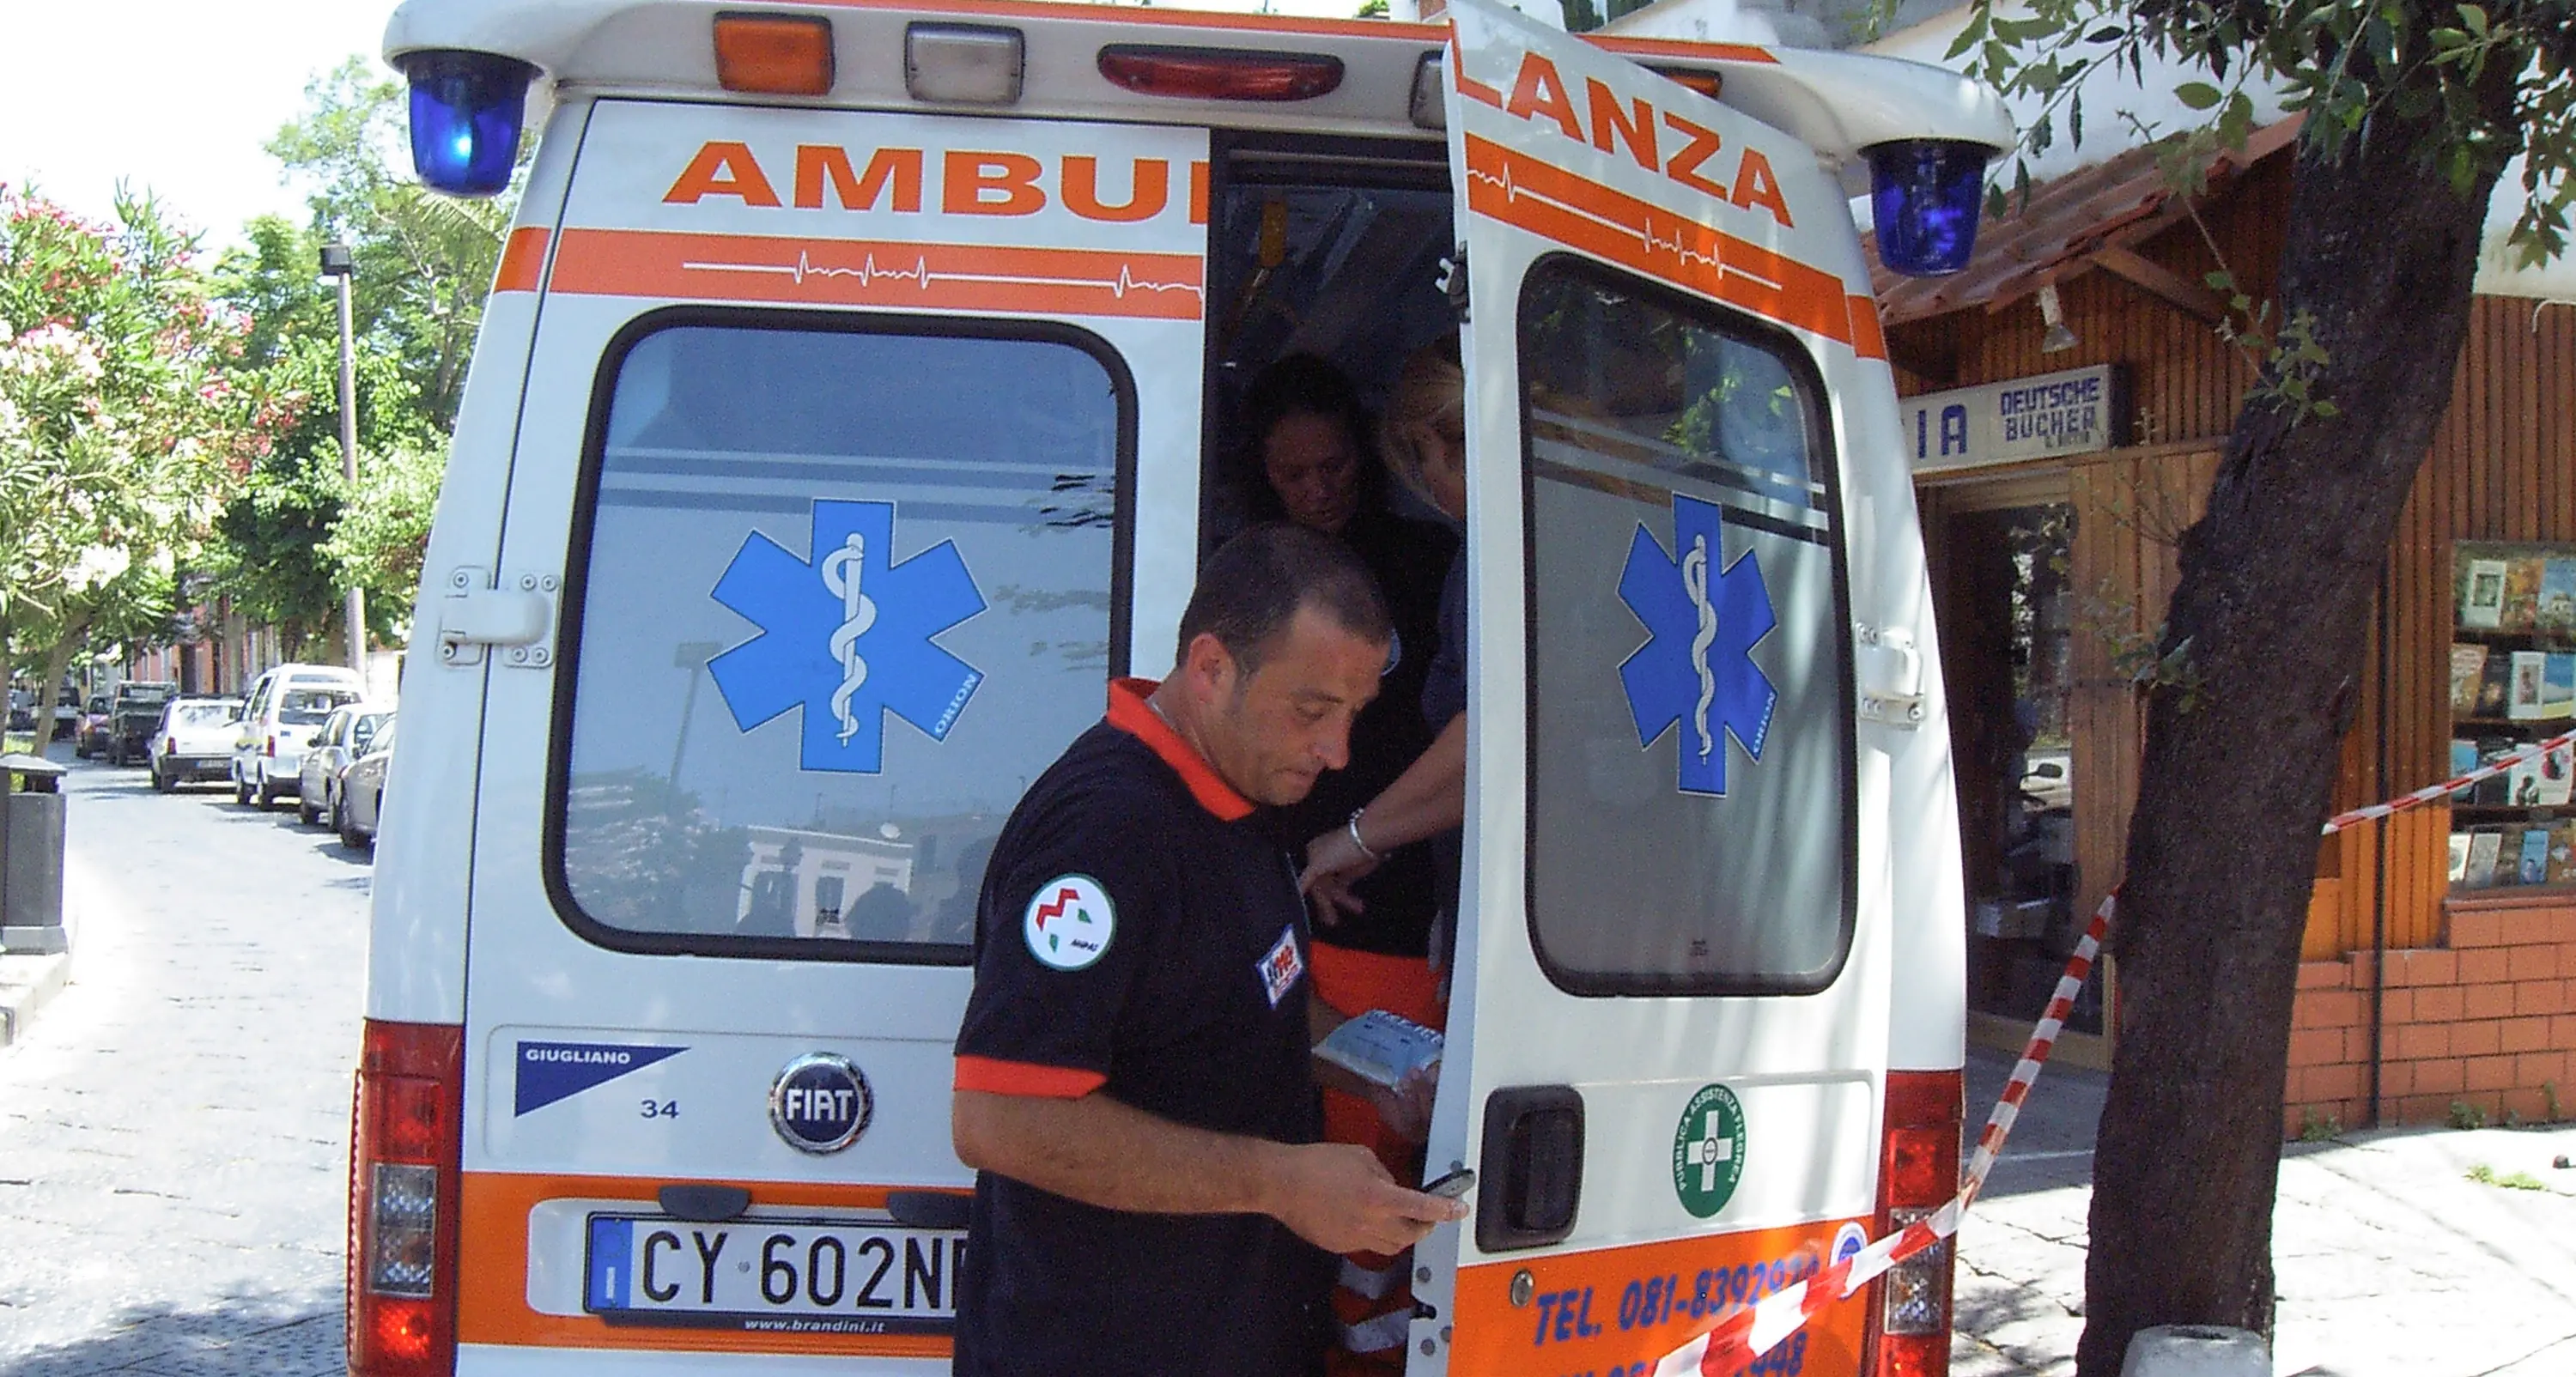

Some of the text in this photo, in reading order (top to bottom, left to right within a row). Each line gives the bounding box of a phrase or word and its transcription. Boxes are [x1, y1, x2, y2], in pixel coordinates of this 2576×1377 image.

[2000, 377, 2100, 416] DEUTSCHE
[934, 673, 977, 733] ORION
[526, 1048, 632, 1065] GIUGLIANO
[641, 1099, 680, 1119] 34
[786, 1089, 854, 1122] FIAT
[1675, 1116, 1692, 1191] PUBBLICA
[1690, 1088, 1739, 1115] ASSISTENZA
[641, 1228, 730, 1305] CY
[744, 1319, 886, 1334] www.brandini.it
[1534, 1285, 1602, 1347] TEL.
